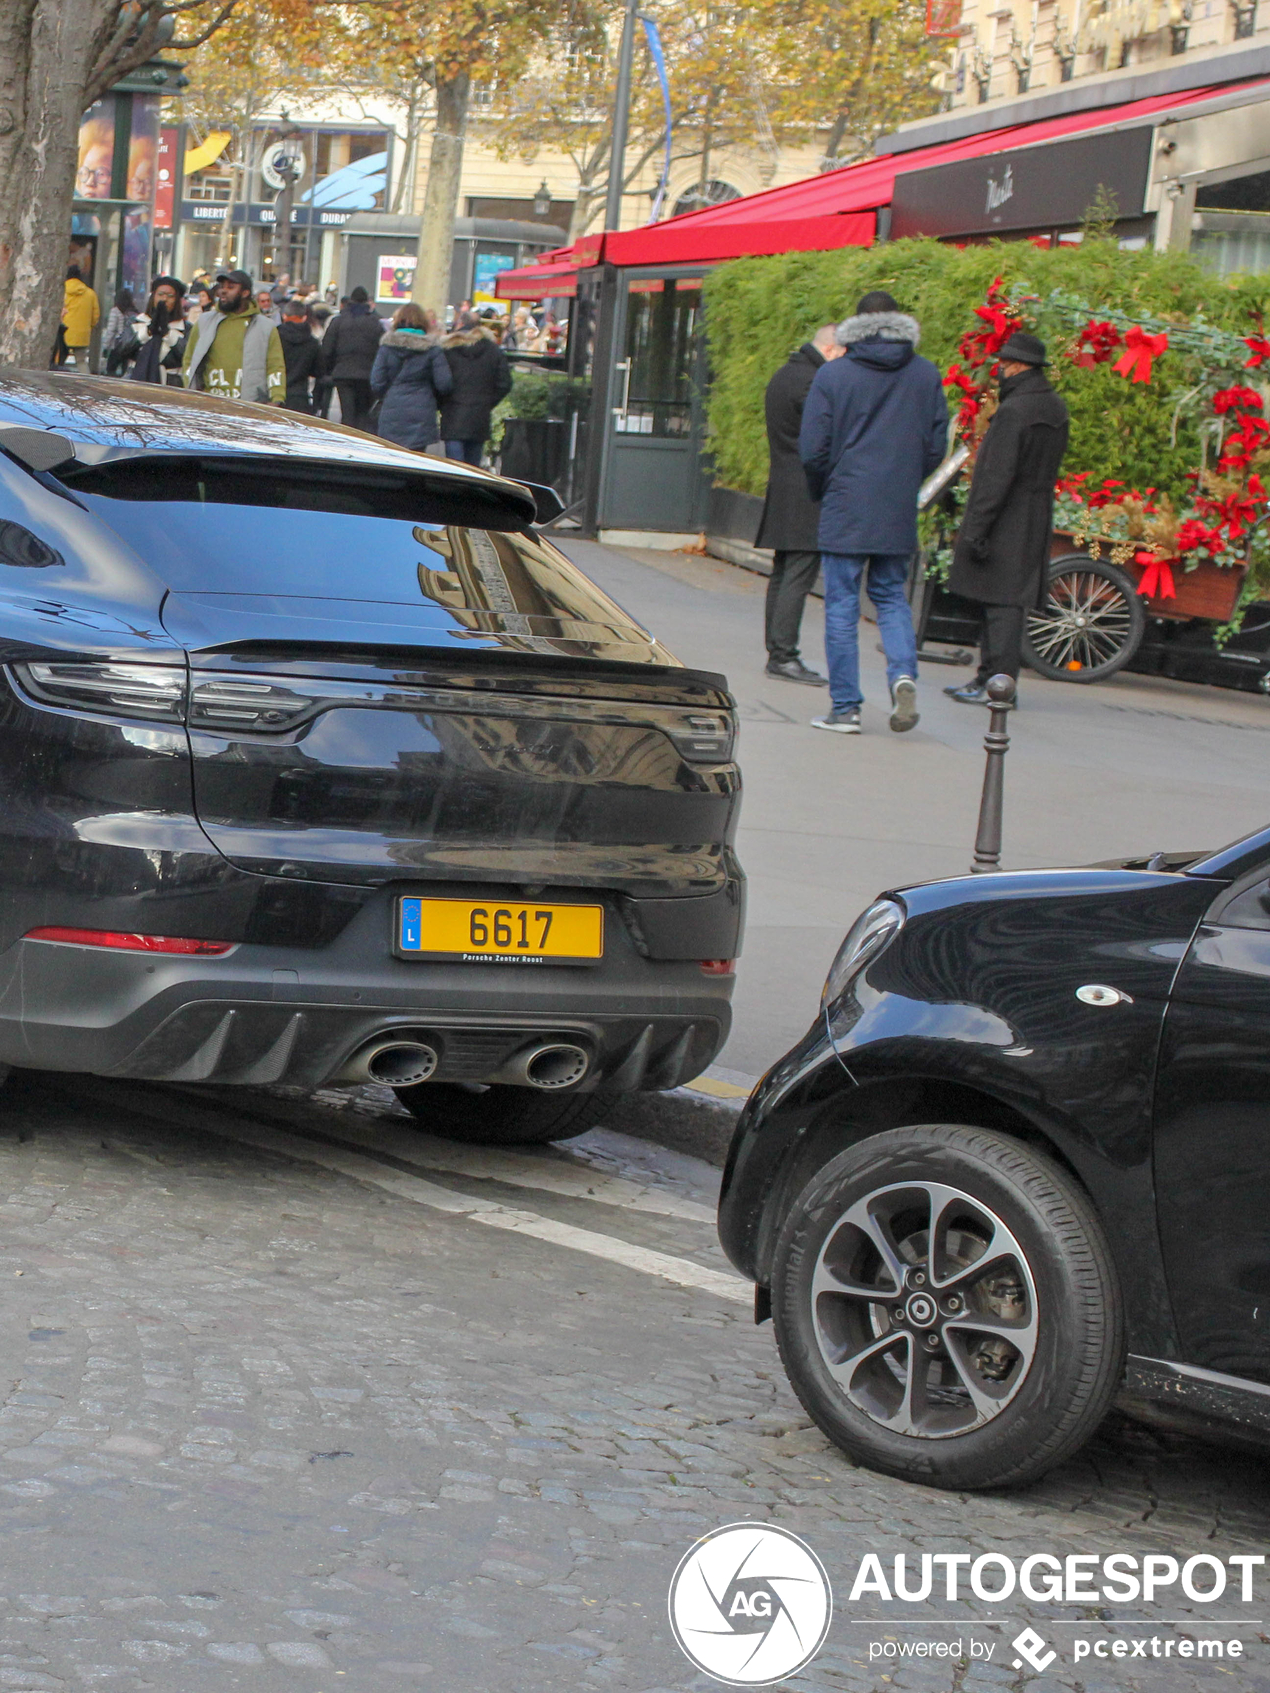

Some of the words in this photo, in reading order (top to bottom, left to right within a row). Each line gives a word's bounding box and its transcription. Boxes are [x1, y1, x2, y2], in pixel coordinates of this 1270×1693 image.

[407, 928, 415, 943] L
[469, 907, 553, 949] 6617
[462, 952, 494, 962] Porsche
